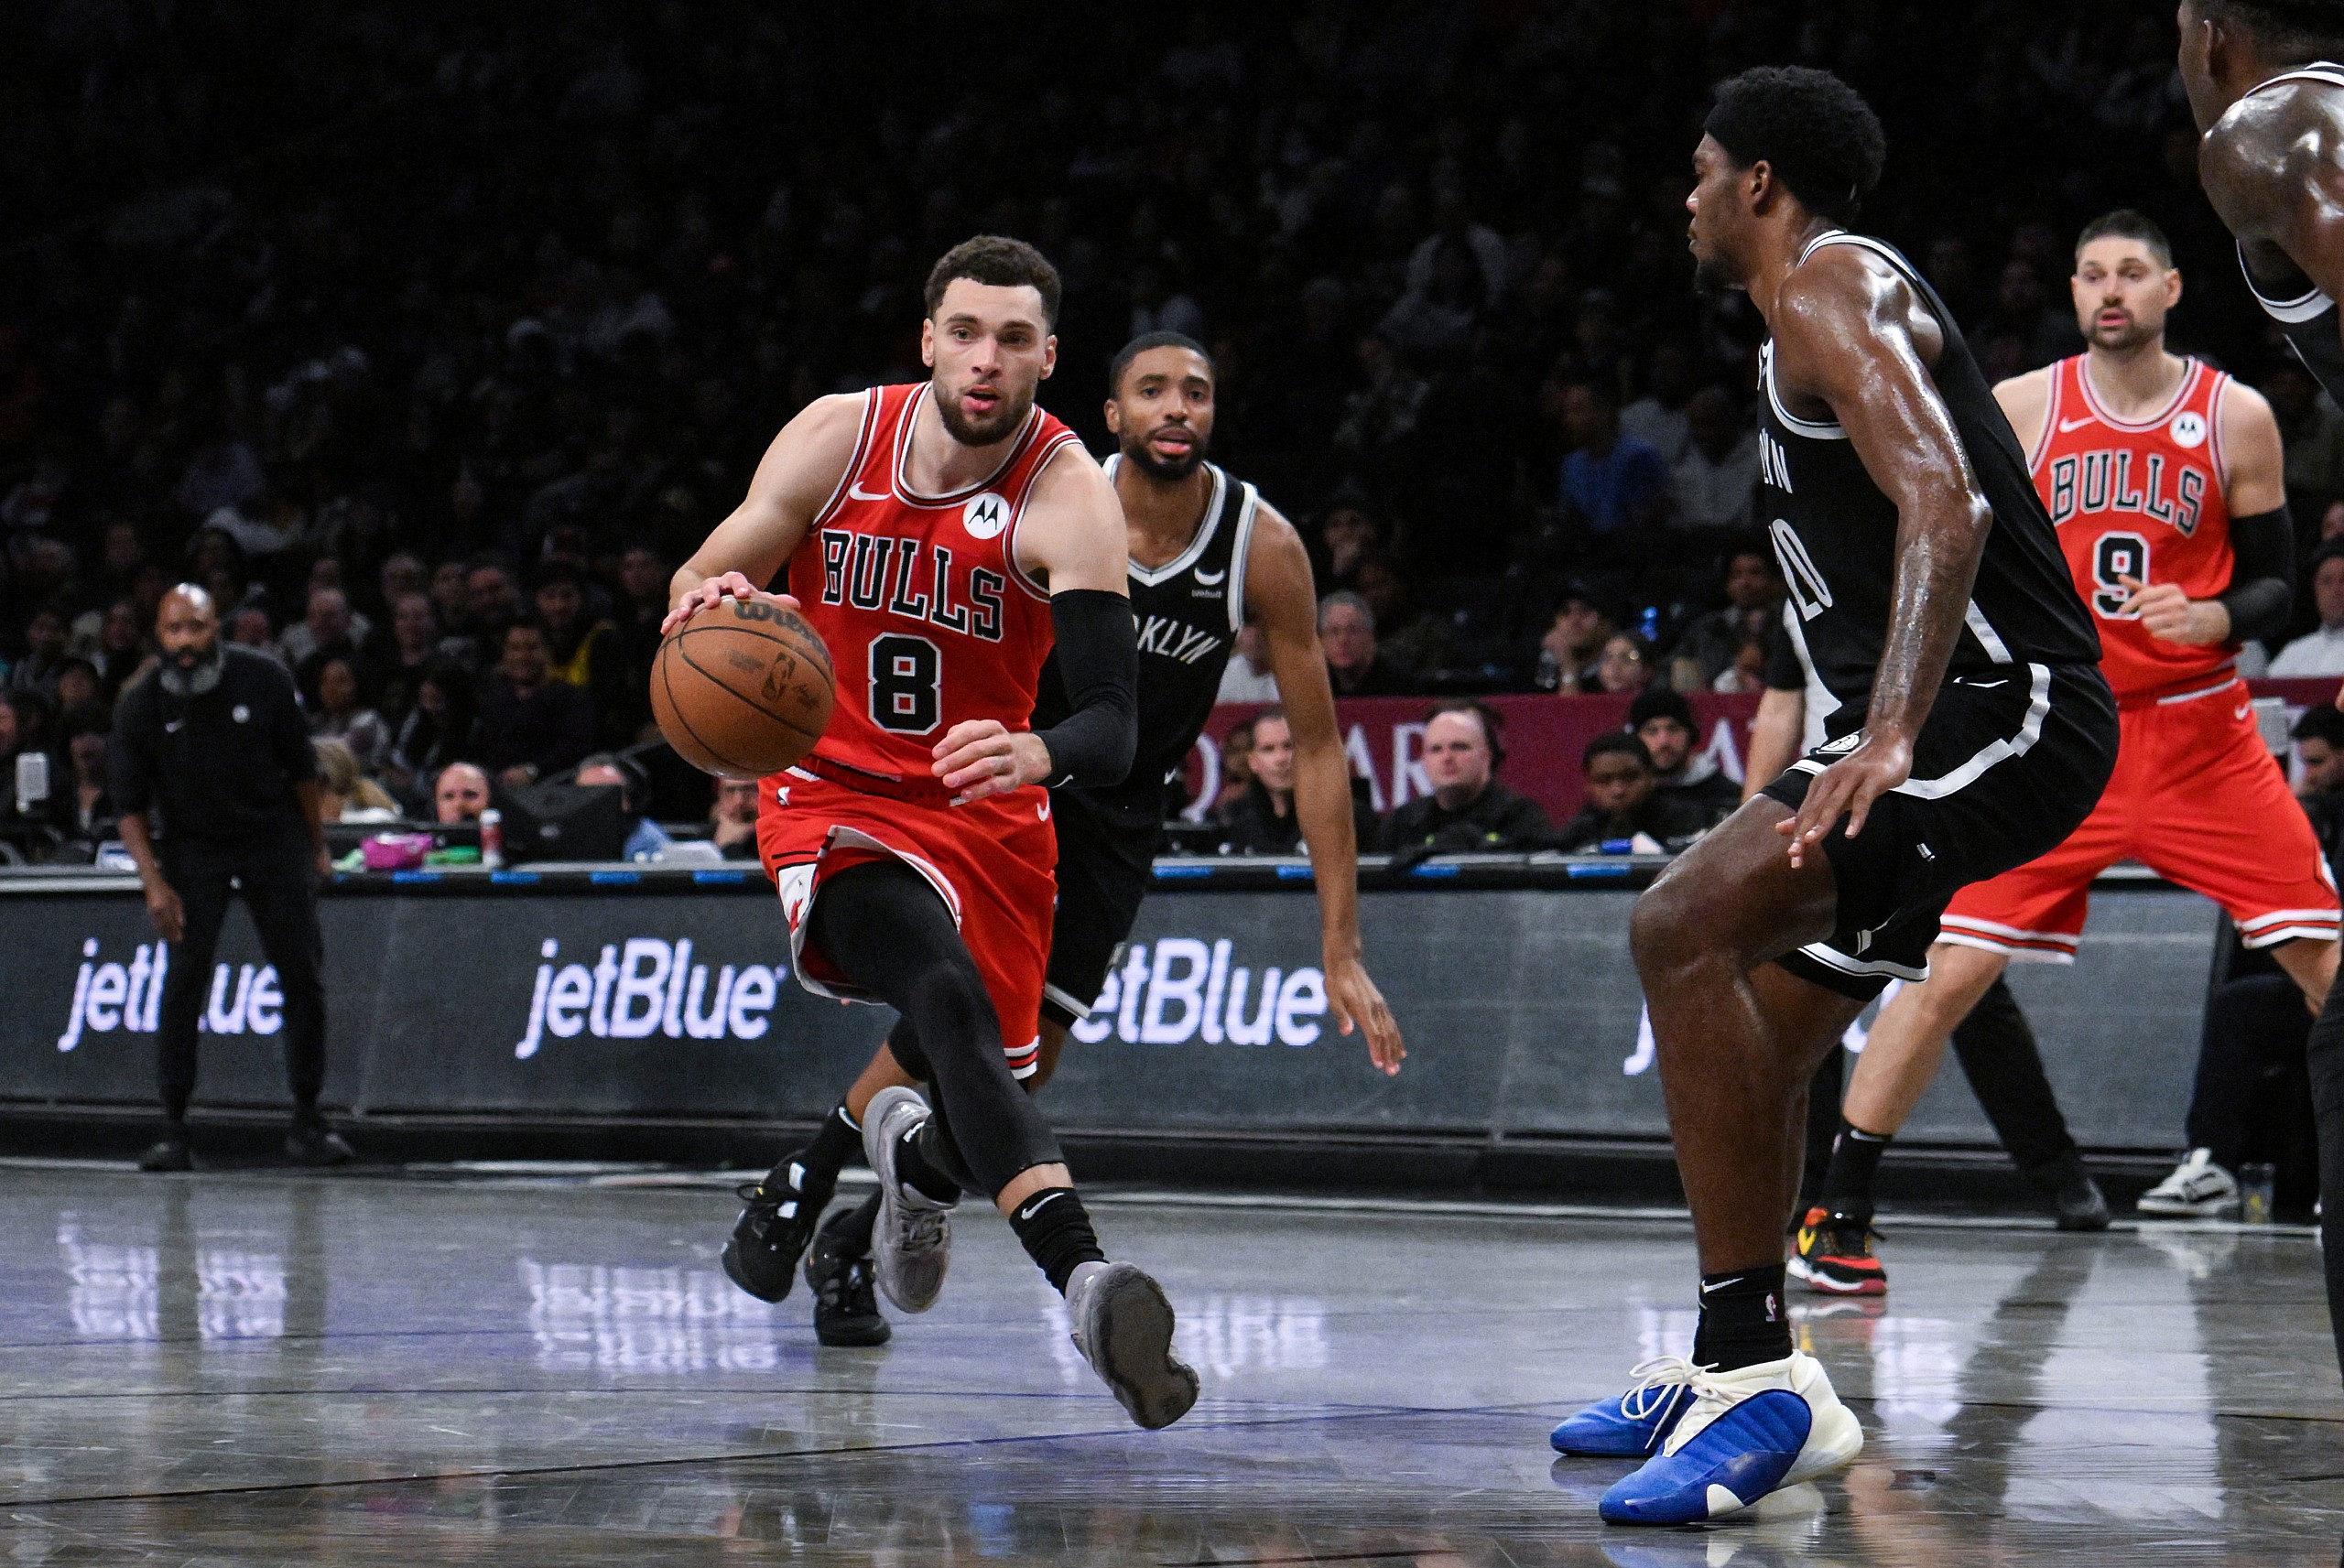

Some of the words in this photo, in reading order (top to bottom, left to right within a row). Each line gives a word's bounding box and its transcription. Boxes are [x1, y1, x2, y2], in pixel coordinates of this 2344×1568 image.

[2050, 449, 2208, 539] BULLS
[820, 527, 1006, 643] BULLS
[2092, 531, 2151, 622] 9
[868, 632, 942, 736] 8
[57, 936, 286, 1052] jetue
[515, 937, 778, 1060] jetBlue
